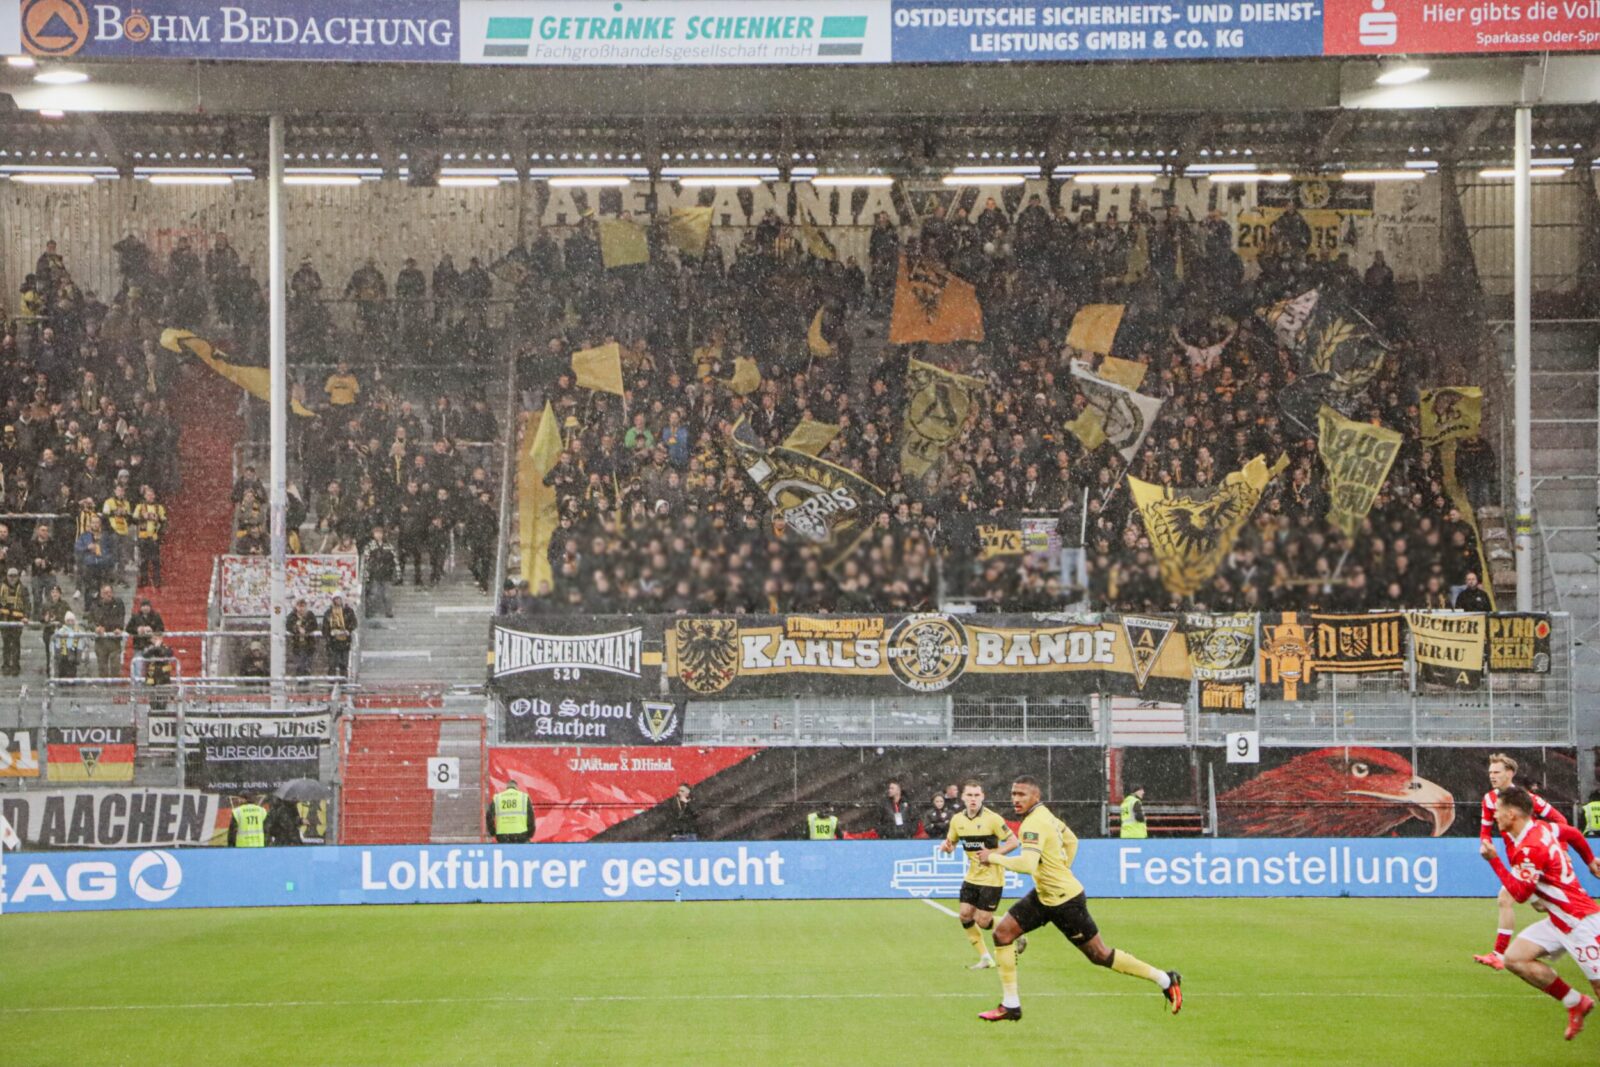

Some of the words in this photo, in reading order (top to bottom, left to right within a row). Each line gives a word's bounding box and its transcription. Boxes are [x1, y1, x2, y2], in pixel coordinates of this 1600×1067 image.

[539, 2, 676, 40] GETRÄNKE
[685, 16, 814, 39] SCHENKER
[894, 9, 1036, 27] OSTDEUTSCHE
[1043, 6, 1181, 25] SICHERHEITS-
[1187, 5, 1233, 22] UND
[1240, 2, 1322, 21] DIENST-
[1423, 5, 1463, 22] Hier
[1470, 3, 1521, 24] gibts
[1527, 2, 1557, 19] die
[93, 5, 210, 42] BÖHM
[220, 7, 453, 46] BEDACHUNG
[970, 32, 1079, 52] LEISTUNGS
[1086, 31, 1146, 50] GMBH
[1153, 31, 1167, 48] &
[1174, 30, 1209, 48] CO.
[1216, 29, 1244, 47] KG
[1476, 32, 1539, 44] Sparkasse
[535, 43, 769, 60] Fachgroßhandelsgesellschaft
[774, 44, 813, 57] mbH
[1411, 611, 1479, 635] OECHER
[1490, 618, 1534, 638] PYRO
[494, 628, 642, 675] FAHRGEMEINSCHAFT
[976, 630, 1116, 666] BANDE
[1418, 641, 1466, 663] KRAU
[1491, 644, 1534, 659] KEIN
[553, 668, 581, 680] 520
[1455, 671, 1470, 685] A
[509, 698, 550, 716] Old
[557, 698, 632, 719] School
[60, 729, 121, 743] TIVOLI
[535, 716, 607, 737] Aachen
[207, 745, 273, 759] EUREGIO
[278, 745, 318, 758] KRAU
[1236, 737, 1250, 757] 9
[437, 763, 449, 782] 8
[501, 799, 518, 809] 208
[39, 793, 208, 844] AACHEN
[362, 849, 586, 890] Lokführer
[602, 847, 785, 897] gesucht
[1119, 846, 1438, 893] Festanstellung
[0, 862, 118, 903] AG
